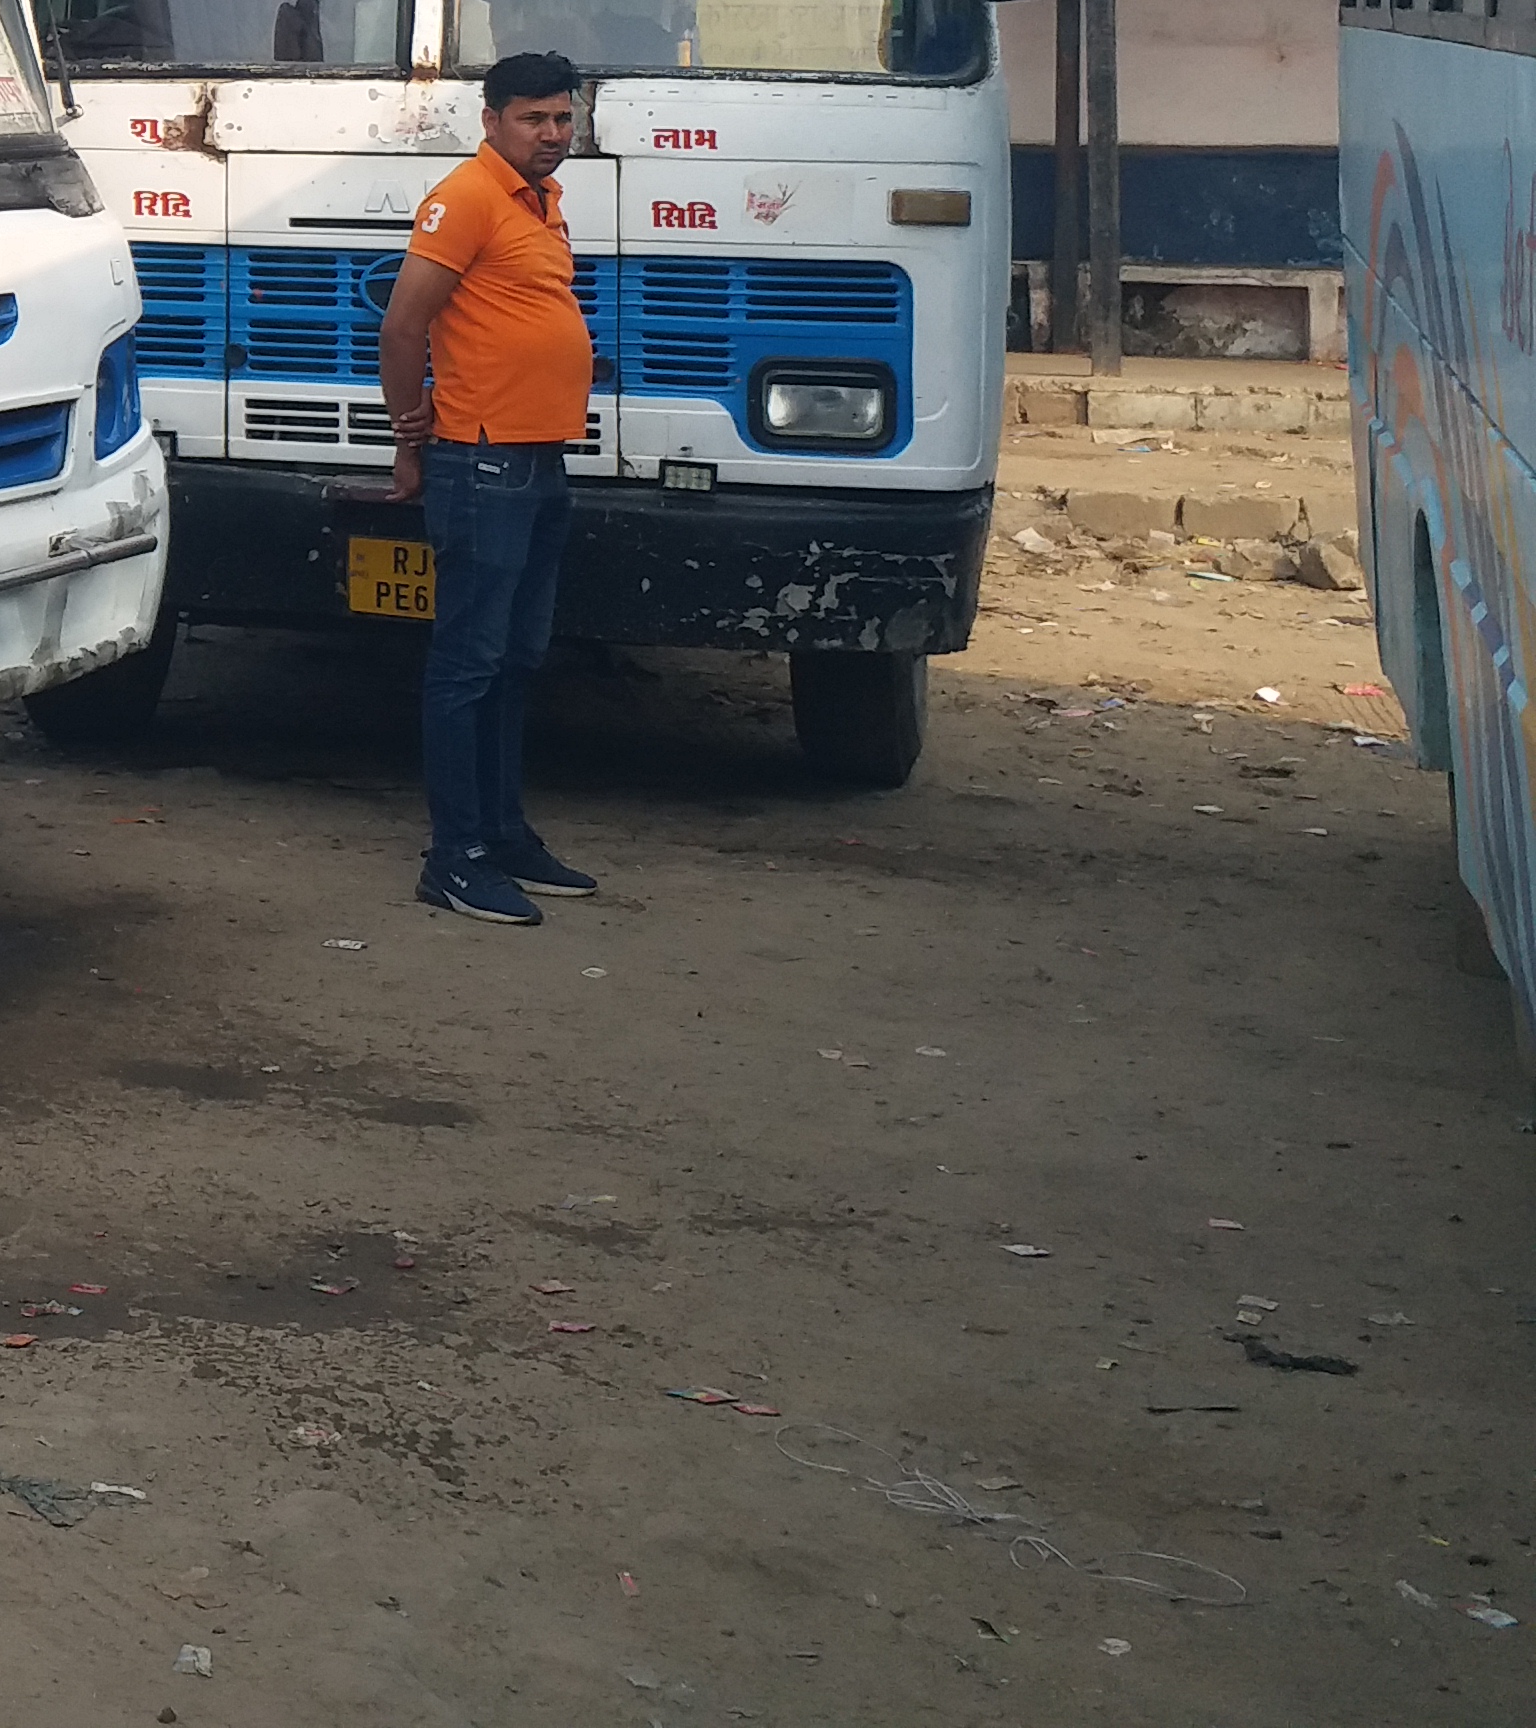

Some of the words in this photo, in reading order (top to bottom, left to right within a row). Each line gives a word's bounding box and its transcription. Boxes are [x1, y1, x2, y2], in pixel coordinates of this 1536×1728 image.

[130, 118, 164, 146] शु
[651, 128, 719, 150] लाभ
[421, 202, 447, 234] 3
[393, 545, 428, 577] RJ
[375, 580, 429, 613] PE6
